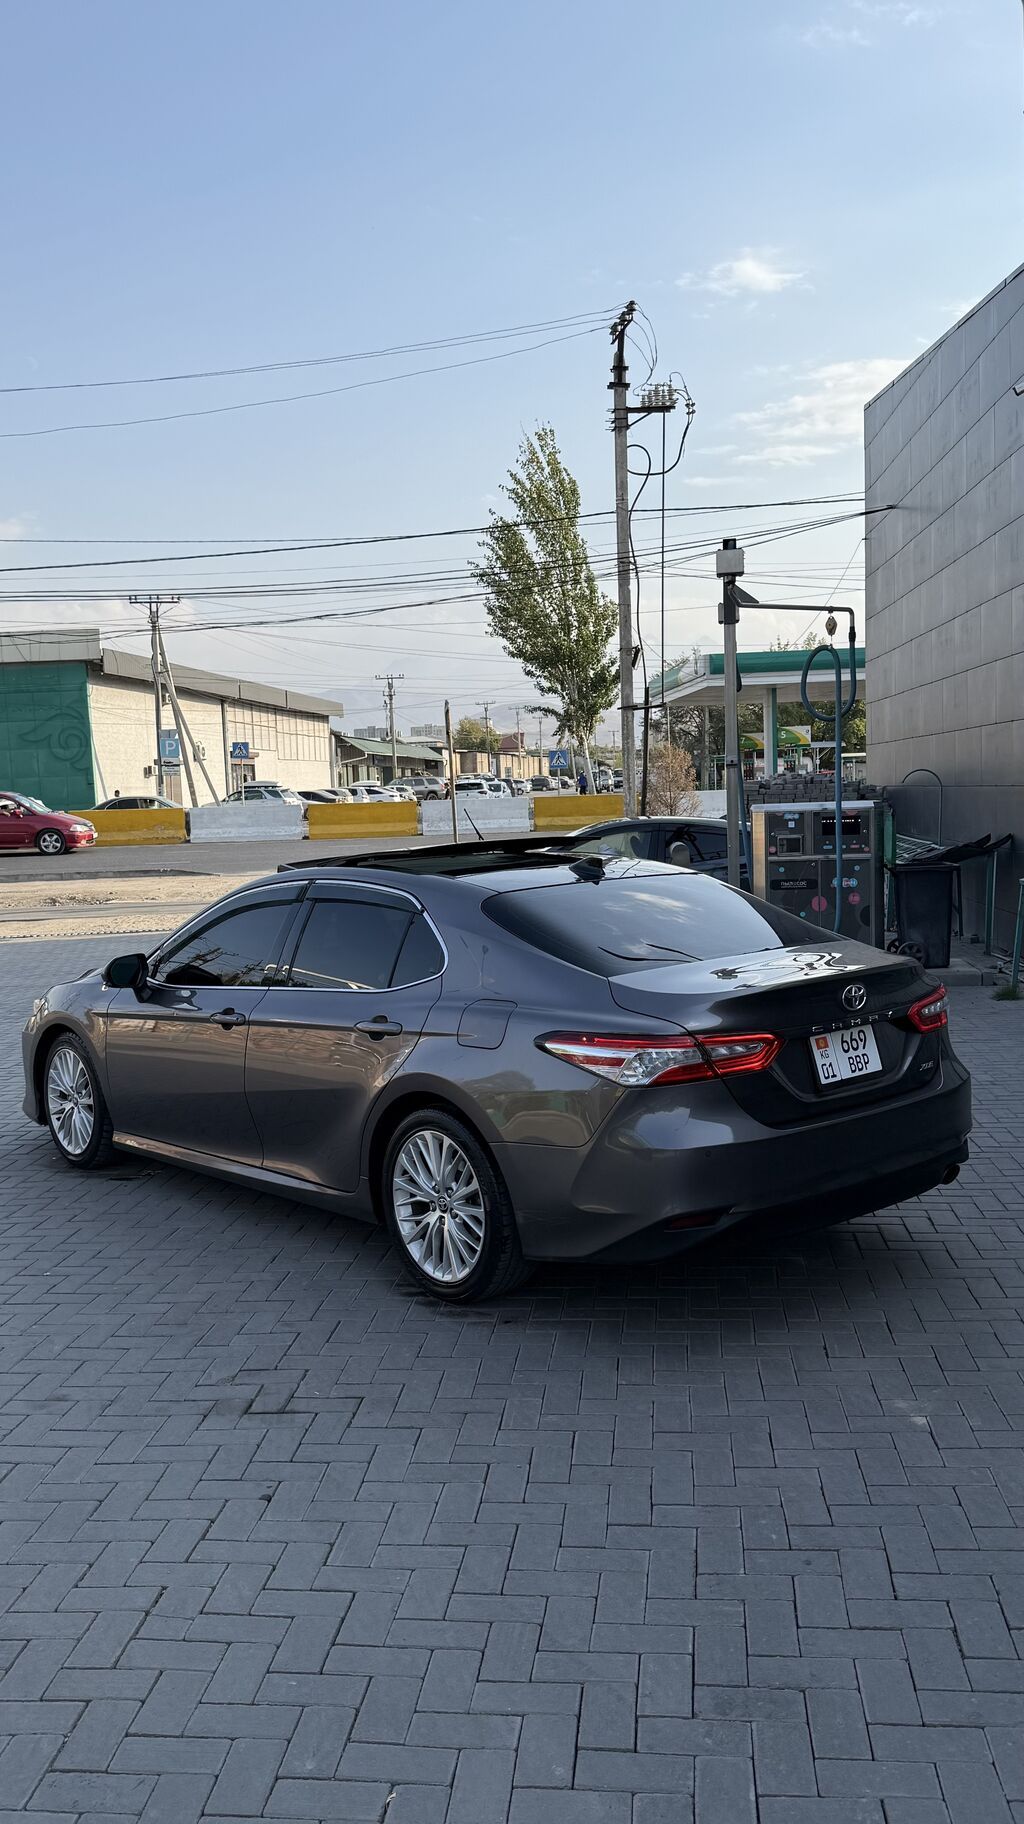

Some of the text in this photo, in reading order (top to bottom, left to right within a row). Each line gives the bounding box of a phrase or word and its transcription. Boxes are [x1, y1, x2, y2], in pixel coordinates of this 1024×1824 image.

[165, 740, 176, 755] P
[841, 1029, 867, 1054] 669
[820, 1050, 830, 1060] KG
[848, 1053, 870, 1074] BBP
[822, 1062, 837, 1080] 01
